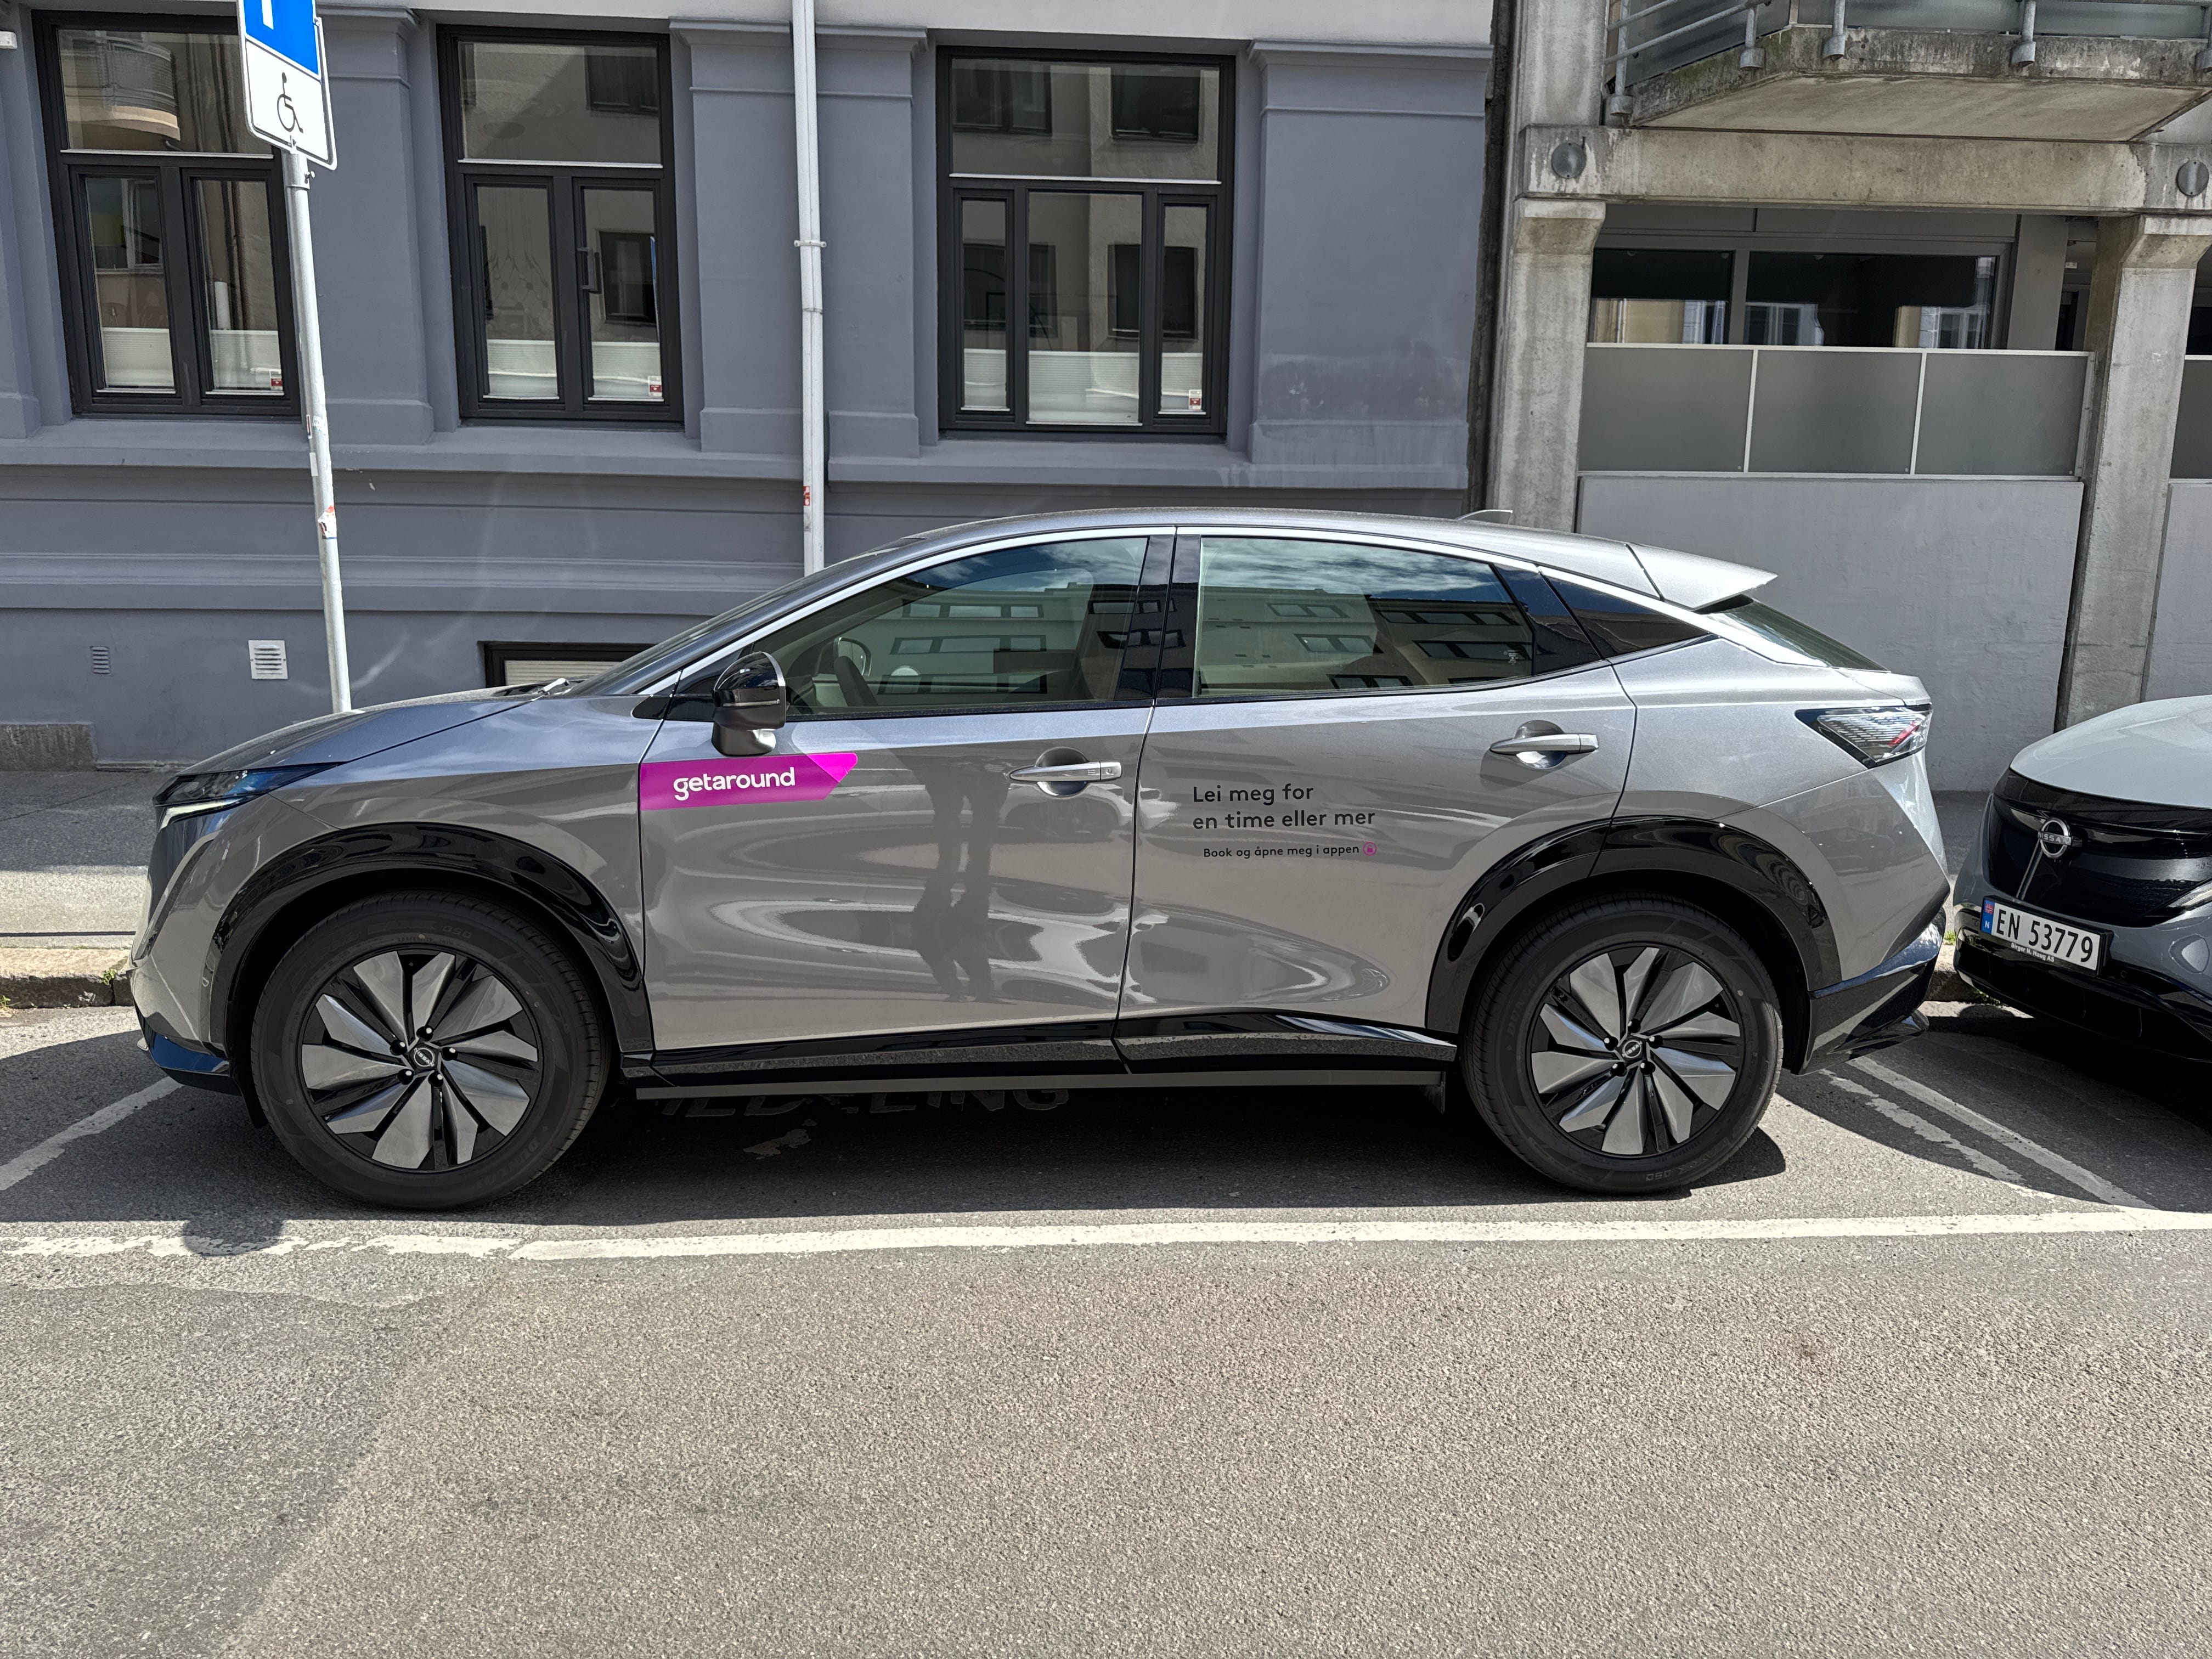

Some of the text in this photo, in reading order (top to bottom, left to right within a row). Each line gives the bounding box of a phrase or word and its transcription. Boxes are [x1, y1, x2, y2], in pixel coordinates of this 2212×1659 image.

[673, 766, 795, 801] getaround
[1193, 783, 1314, 806] Lei meg for
[1193, 810, 1375, 830] en time eller mer
[2038, 831, 2071, 845] NISSAN
[1204, 846, 1359, 859] Book og åpne meg i appen
[1984, 920, 1990, 929] N
[1996, 909, 2094, 963] EN 53779
[2011, 942, 2026, 954] Birger
[2033, 950, 2047, 962] Haug
[413, 1047, 435, 1068] NISSAN
